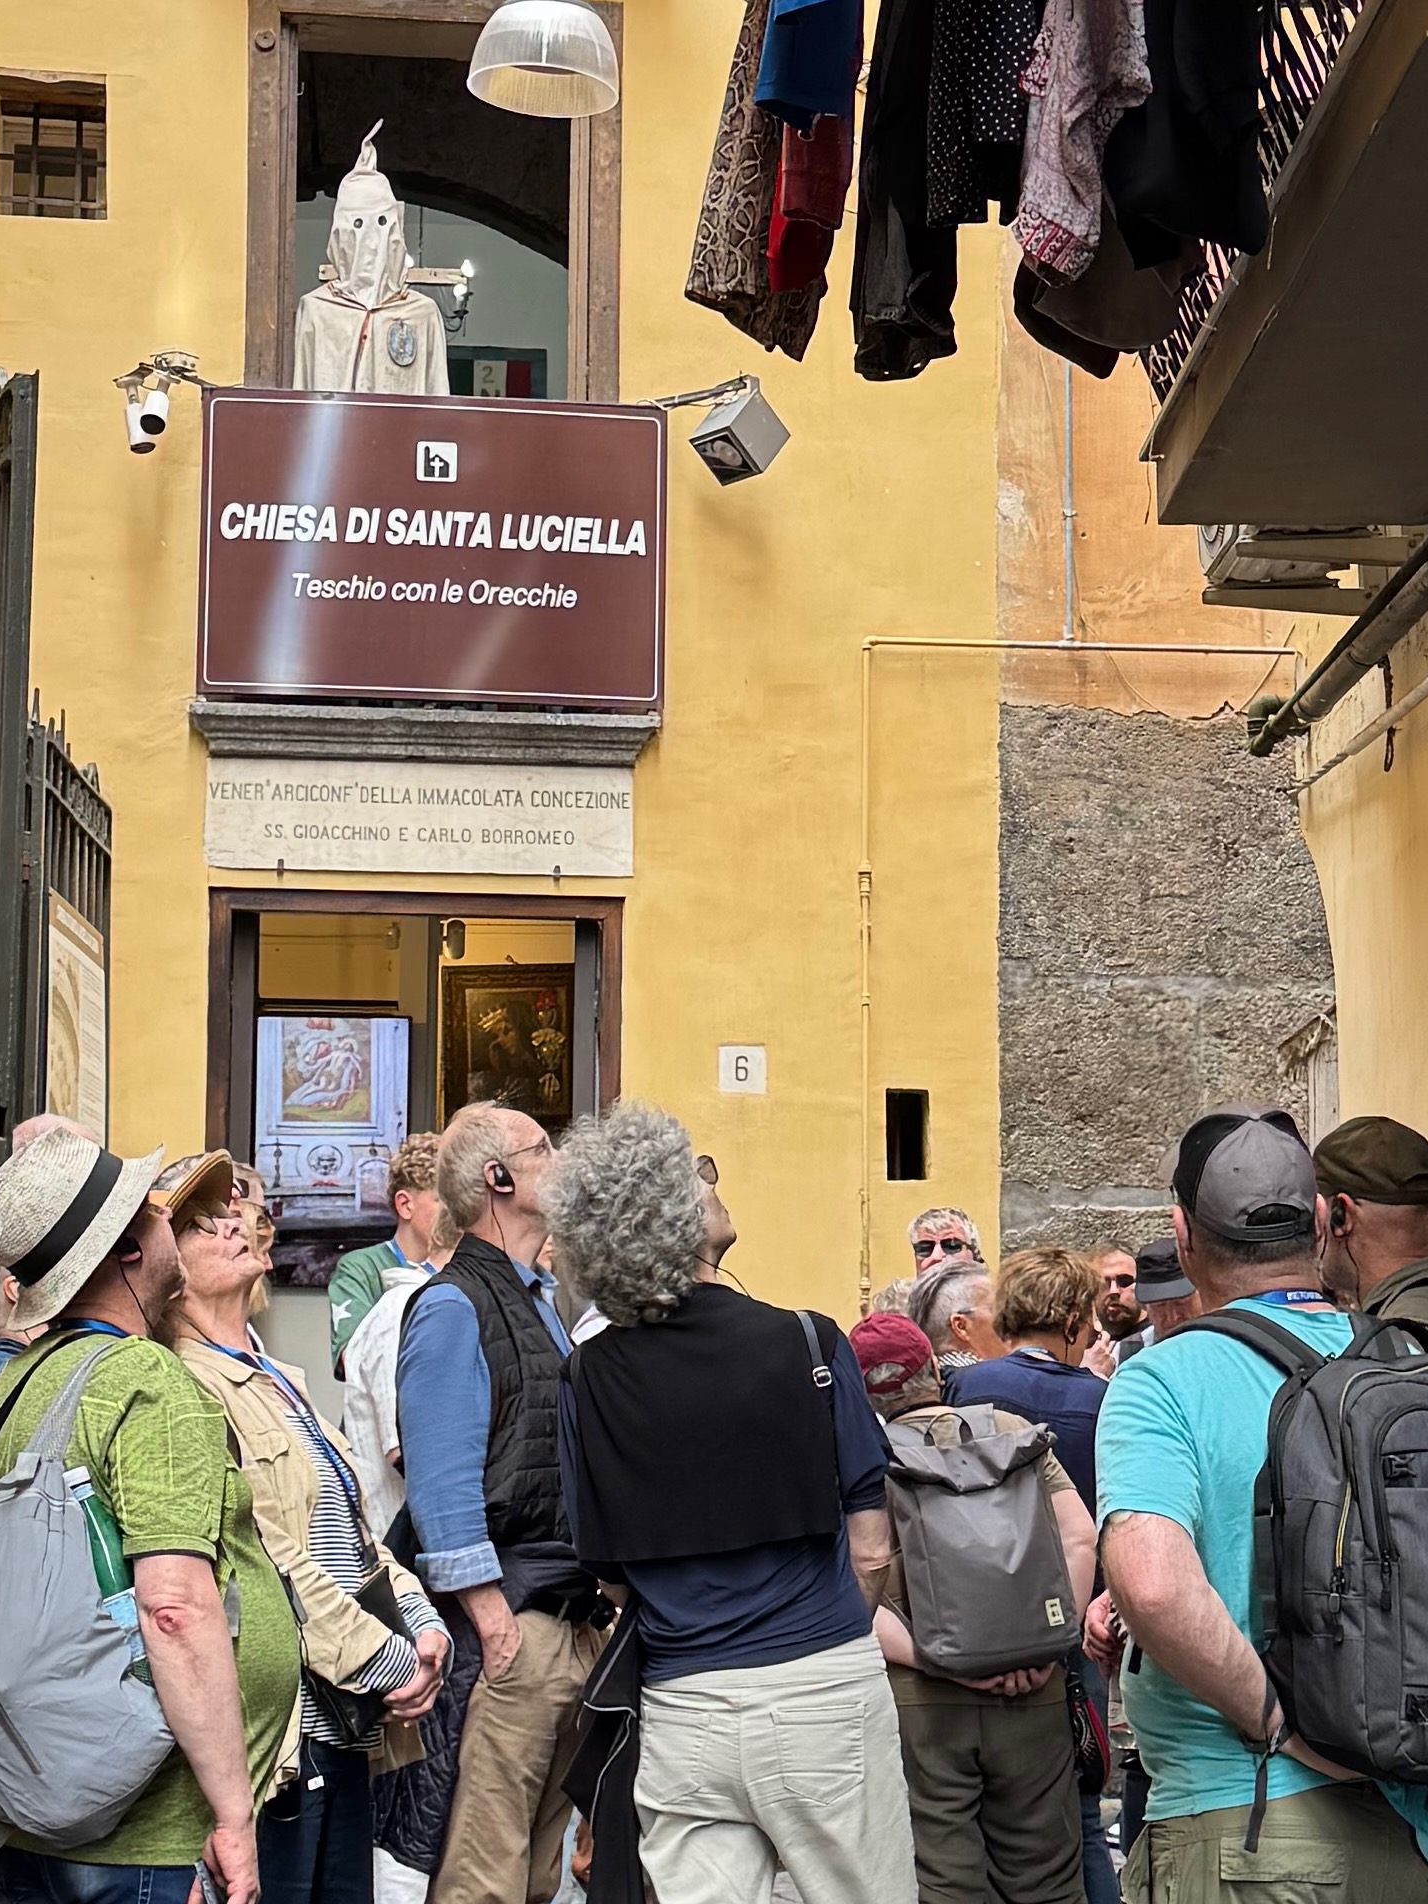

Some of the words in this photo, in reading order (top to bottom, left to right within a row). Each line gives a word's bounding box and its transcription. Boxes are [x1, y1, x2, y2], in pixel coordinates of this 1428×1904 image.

[219, 502, 338, 543] CHIESA
[345, 508, 380, 543] DI
[385, 509, 492, 548] SANTA
[500, 514, 646, 555] LUCIELLA
[291, 572, 386, 601] Teschio
[392, 583, 436, 601] con
[441, 579, 463, 603] le
[469, 580, 577, 607] Orecchie
[359, 786, 413, 804] DELLA
[417, 788, 524, 807] IMMACOLATA
[531, 790, 630, 810] CONCEZIONE
[293, 824, 390, 841] GIOACCHINO
[398, 827, 409, 842] E
[417, 827, 472, 844] CARLO
[481, 829, 575, 846] BORROMEO
[734, 1055, 749, 1082] 6
